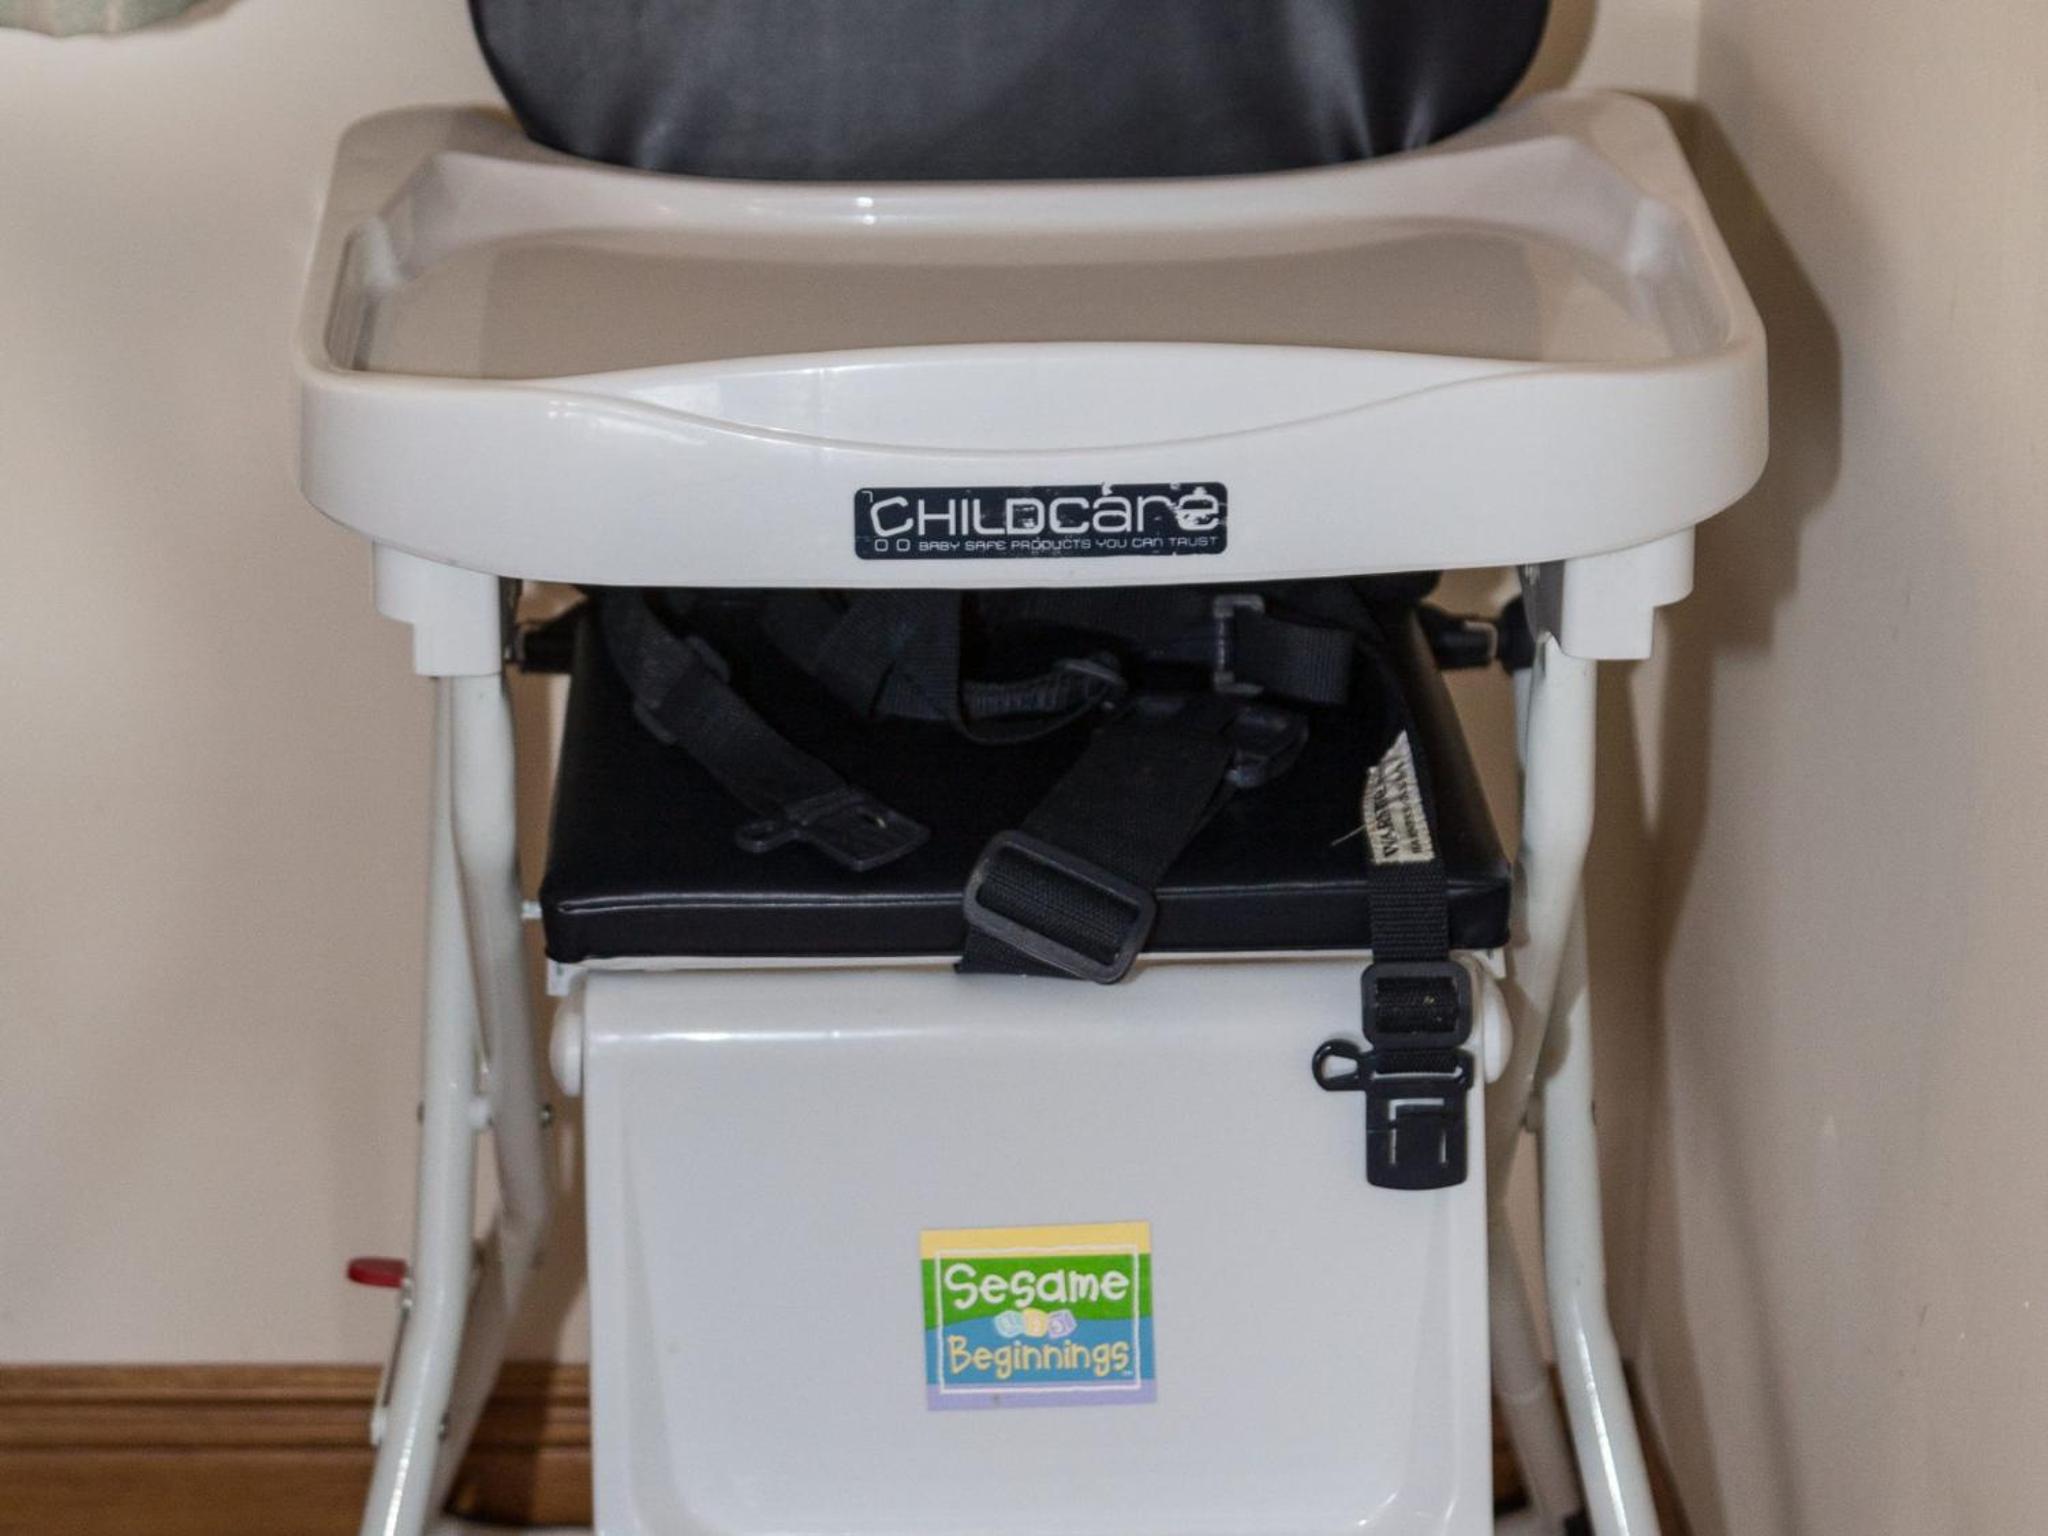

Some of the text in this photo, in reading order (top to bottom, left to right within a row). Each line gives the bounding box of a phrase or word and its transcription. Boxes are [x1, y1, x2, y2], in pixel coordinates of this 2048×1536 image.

[918, 540, 960, 551] BABY
[965, 539, 1006, 551] SAFE
[1010, 538, 1092, 551] PRODUCTS
[1096, 538, 1127, 550] YOU
[1168, 535, 1219, 547] TRUST
[944, 1263, 1130, 1309] Sesame
[947, 1334, 1129, 1379] Beginnings
